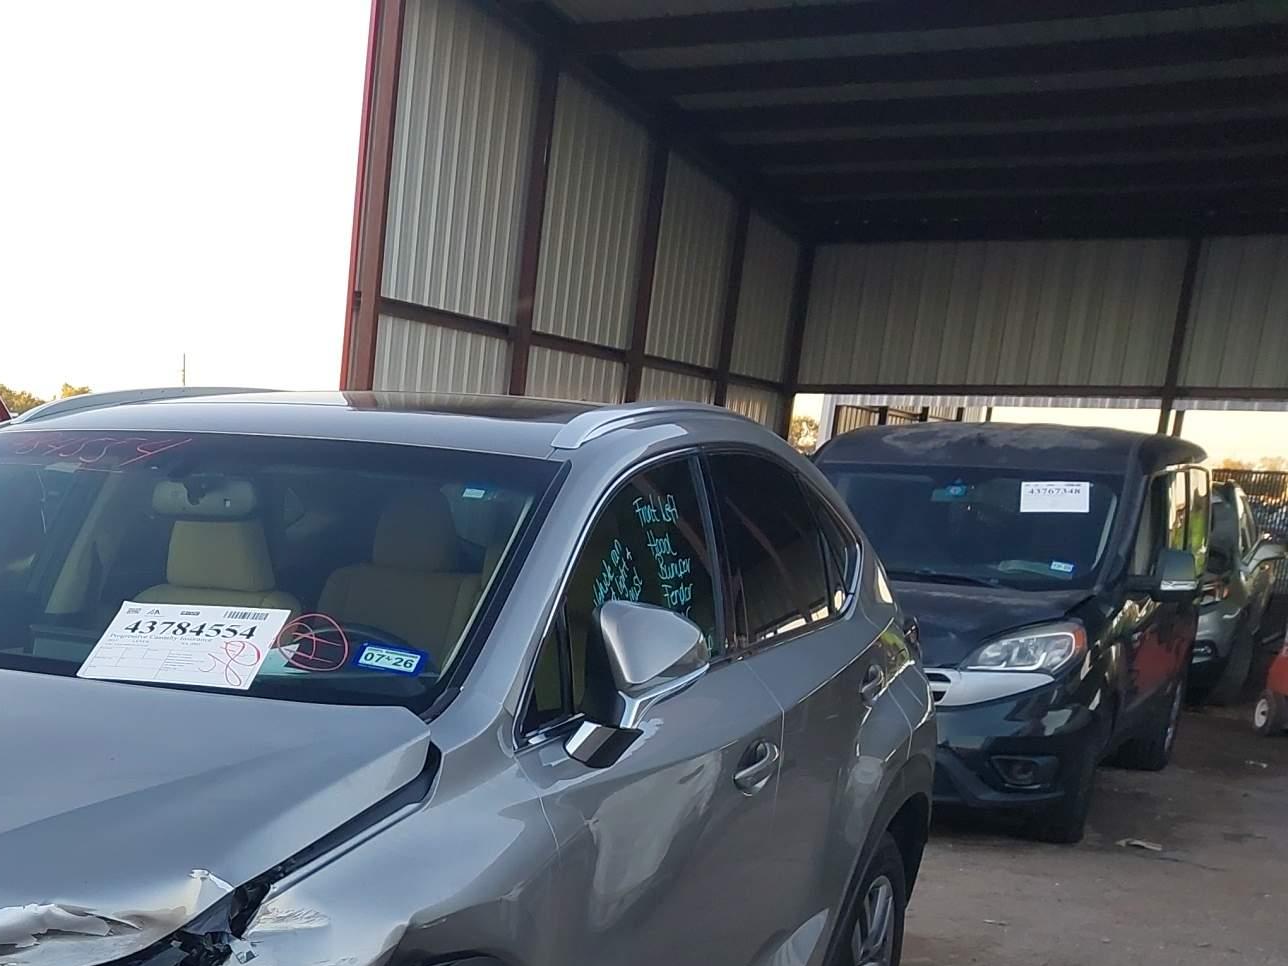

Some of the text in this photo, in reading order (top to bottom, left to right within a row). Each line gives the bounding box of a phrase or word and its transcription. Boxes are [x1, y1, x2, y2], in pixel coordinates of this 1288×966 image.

[124, 619, 258, 640] 43784554
[363, 651, 387, 663] 07
[391, 657, 415, 669] 26
